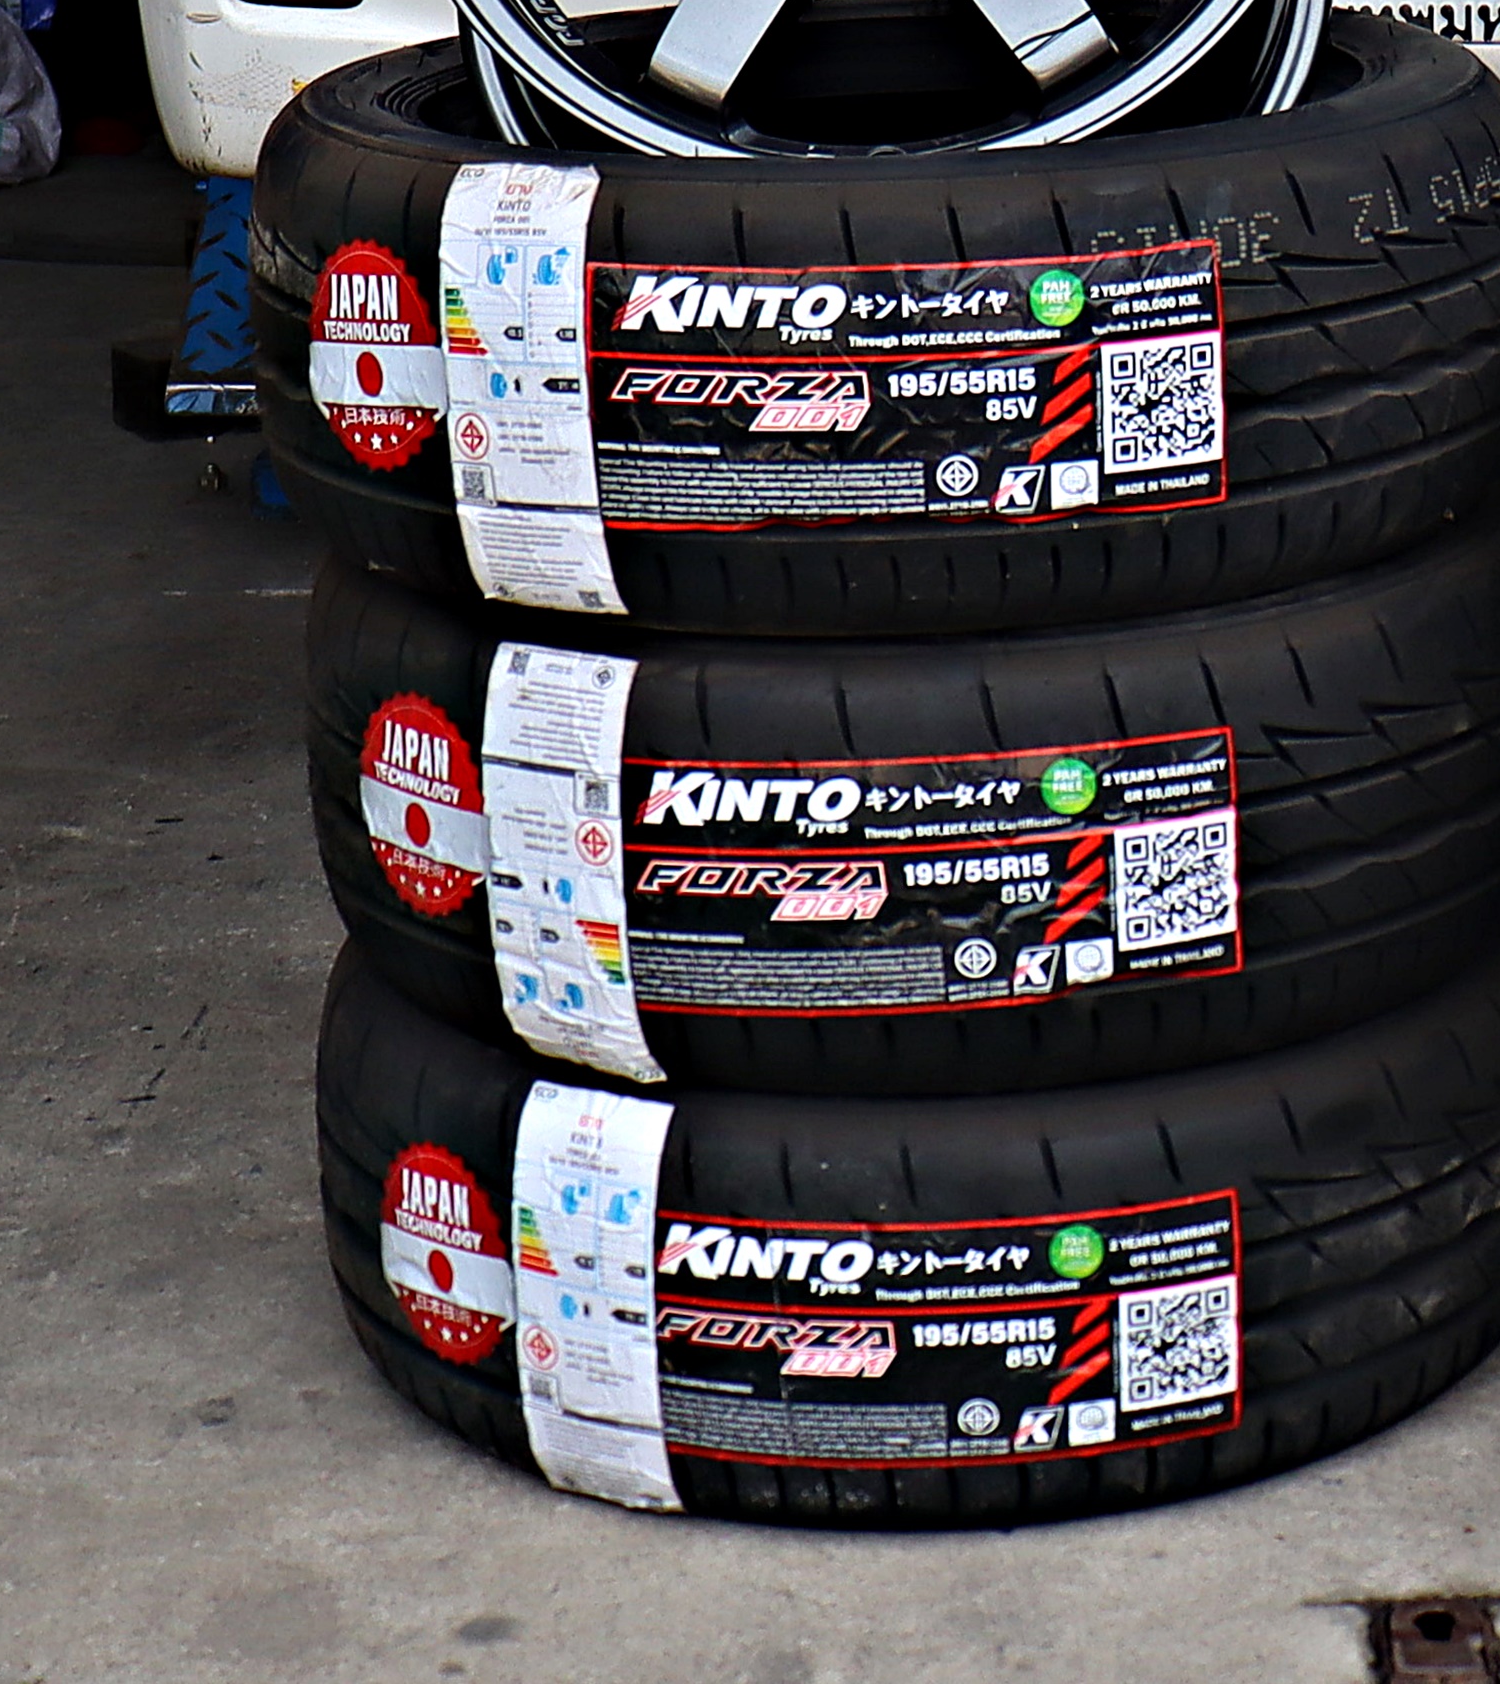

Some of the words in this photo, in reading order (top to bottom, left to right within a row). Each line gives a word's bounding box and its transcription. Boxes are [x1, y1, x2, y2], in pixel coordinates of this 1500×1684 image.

[496, 199, 532, 212] KINTO
[329, 273, 399, 321] JAPAN
[1090, 285, 1101, 300] 2
[1101, 281, 1143, 298] YEARS
[1143, 272, 1213, 292] WARRANTY
[614, 275, 848, 333] KINTO
[850, 288, 1010, 320] キントータイヤ
[1111, 302, 1130, 316] OR
[322, 319, 412, 344] TECHNOLOGY
[779, 325, 834, 346] Tyres
[848, 334, 899, 350] Through
[984, 328, 1061, 344] Certification
[608, 367, 871, 405] FORZA
[887, 367, 1037, 399] 195/55R15
[343, 406, 407, 427] 日本技術
[749, 402, 871, 433] 001
[985, 395, 1038, 423] 85V
[381, 719, 450, 782] JAPAN
[373, 760, 461, 806] TECHNOLOGY
[1102, 773, 1112, 787] 2
[1112, 767, 1156, 786] YEARS
[1157, 758, 1227, 780] WARRANTY
[638, 771, 862, 827] KINTO
[864, 780, 1022, 813] キントータイヤ
[796, 818, 850, 838] Tyres
[634, 860, 889, 895] FORZA
[903, 853, 1050, 887] 195/55R15
[770, 892, 889, 921] 001
[1000, 881, 1051, 904] 85V
[401, 1167, 471, 1228] JAPAN
[394, 1207, 483, 1253] TECHNOLOGY
[657, 1222, 874, 1283] KINTO
[876, 1244, 1031, 1276] キントータイヤ
[808, 1276, 862, 1297] Tyres
[656, 1307, 897, 1351] FORZA
[912, 1317, 1057, 1347] 195/55R15
[780, 1348, 897, 1378] 001
[1005, 1344, 1058, 1368] 85V
